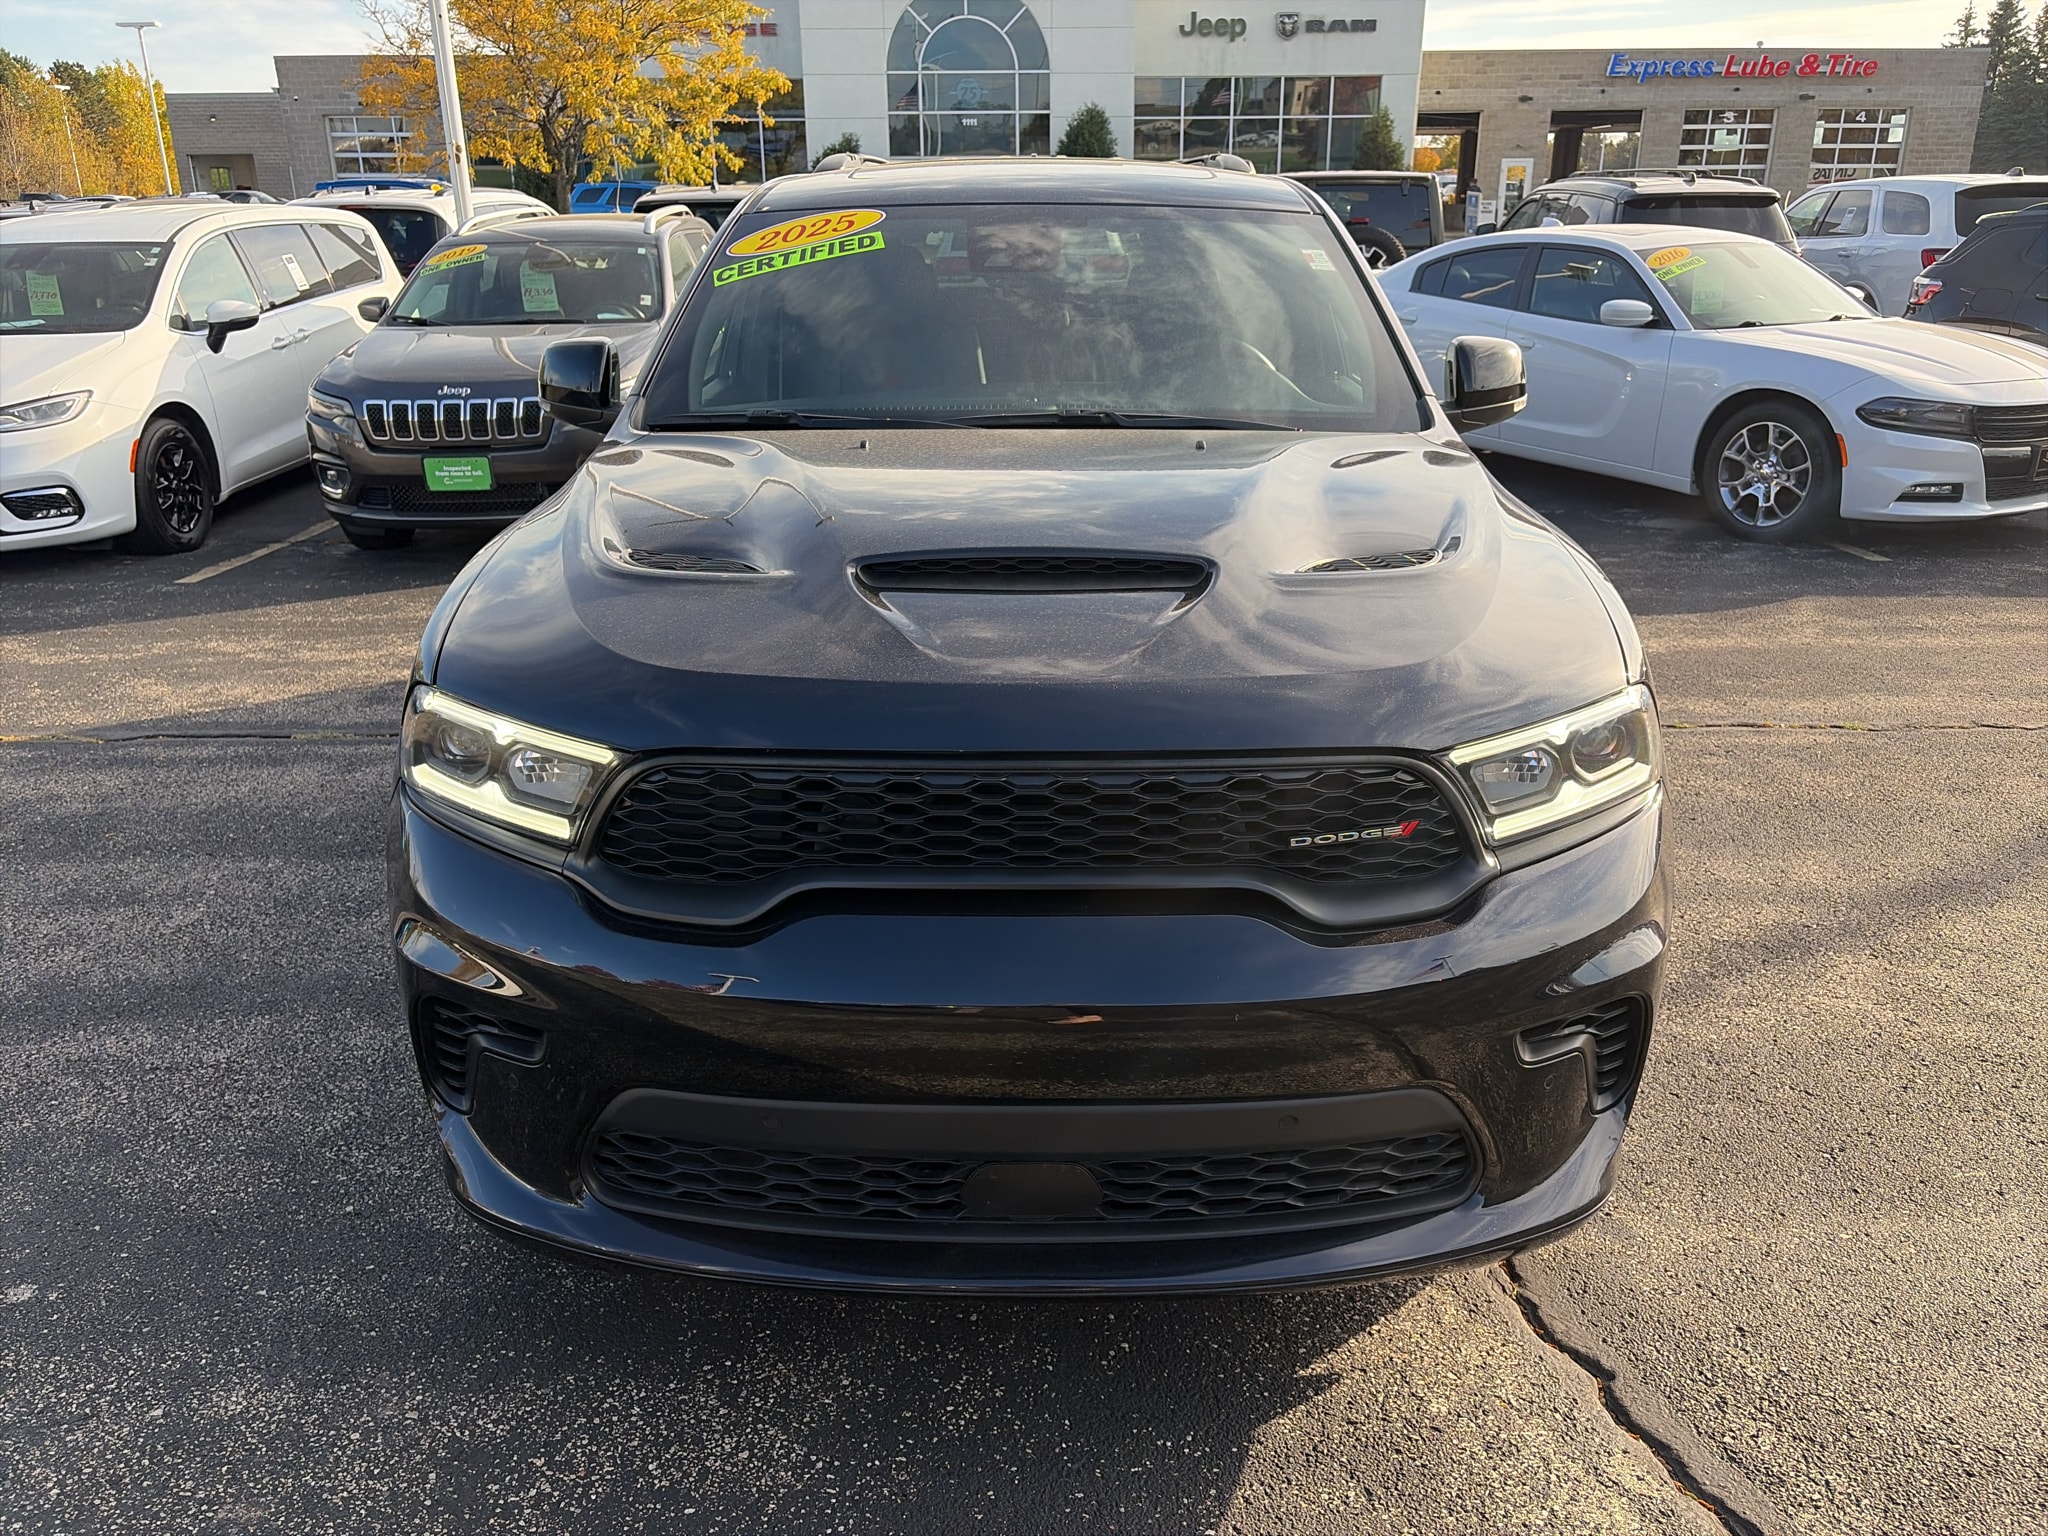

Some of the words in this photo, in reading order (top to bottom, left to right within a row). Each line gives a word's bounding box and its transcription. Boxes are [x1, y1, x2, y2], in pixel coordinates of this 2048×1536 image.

[1179, 11, 1247, 42] Jeep
[1305, 19, 1378, 33] RAM
[1606, 53, 1718, 84] Express
[1722, 54, 1791, 78] Lube
[1796, 53, 1820, 77] &
[1826, 54, 1879, 78] Tire
[1723, 111, 1735, 123] 3
[1855, 111, 1867, 123] 4
[754, 213, 858, 252] 2025
[421, 265, 441, 275] ONE
[446, 255, 483, 268] OWNER
[436, 246, 477, 263] 2019
[716, 235, 877, 283] CERTIFIED
[1654, 248, 1685, 266] 2016
[1658, 267, 1676, 279] ONE
[1677, 257, 1704, 271] OWNER
[1290, 825, 1403, 847] DODGE
